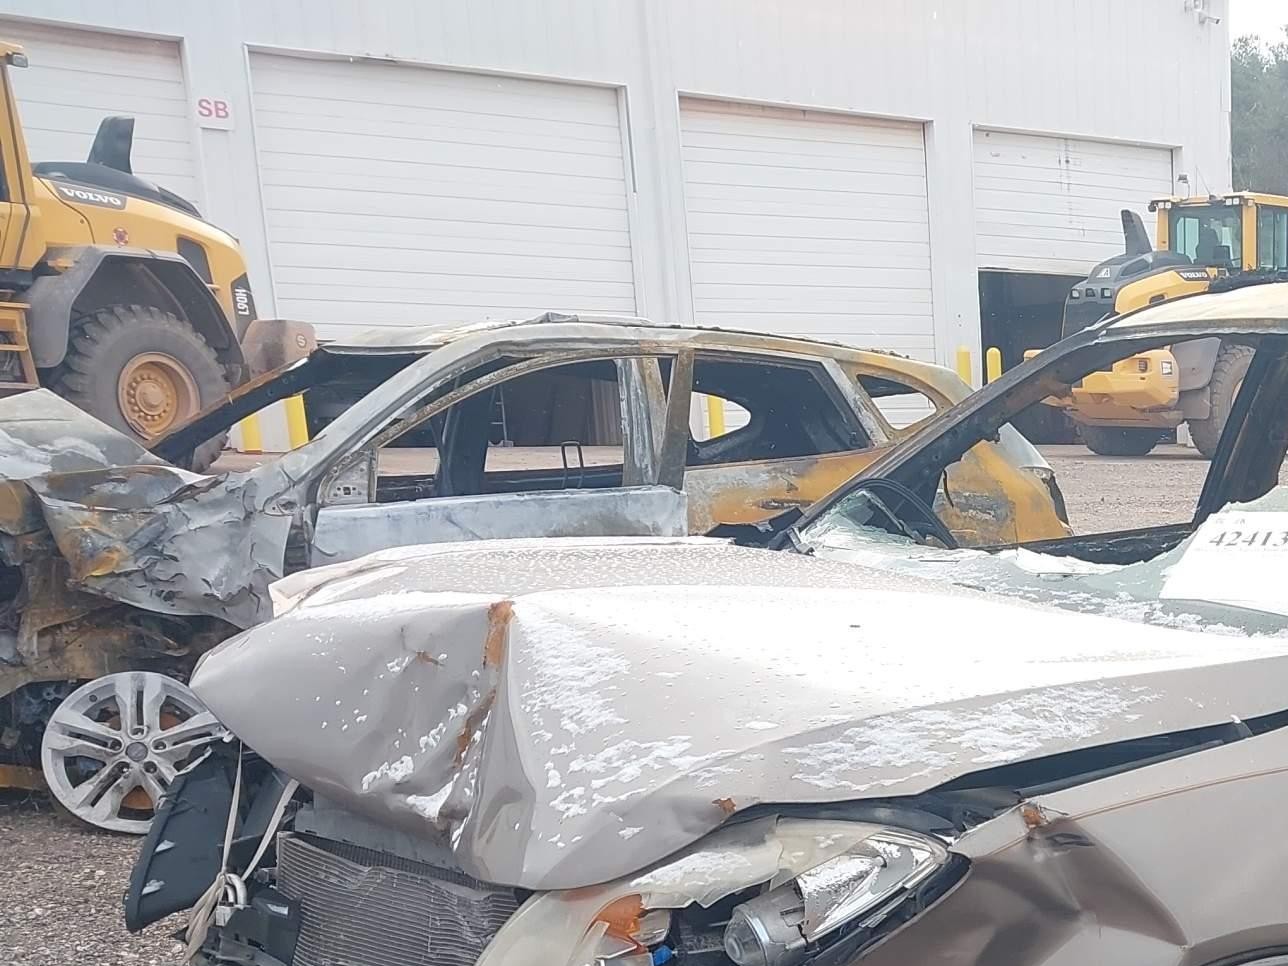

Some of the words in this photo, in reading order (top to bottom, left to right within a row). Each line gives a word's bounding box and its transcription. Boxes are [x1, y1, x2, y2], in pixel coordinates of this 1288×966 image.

[198, 99, 229, 119] SB
[60, 187, 121, 206] VOLVO
[235, 287, 250, 316] L90H
